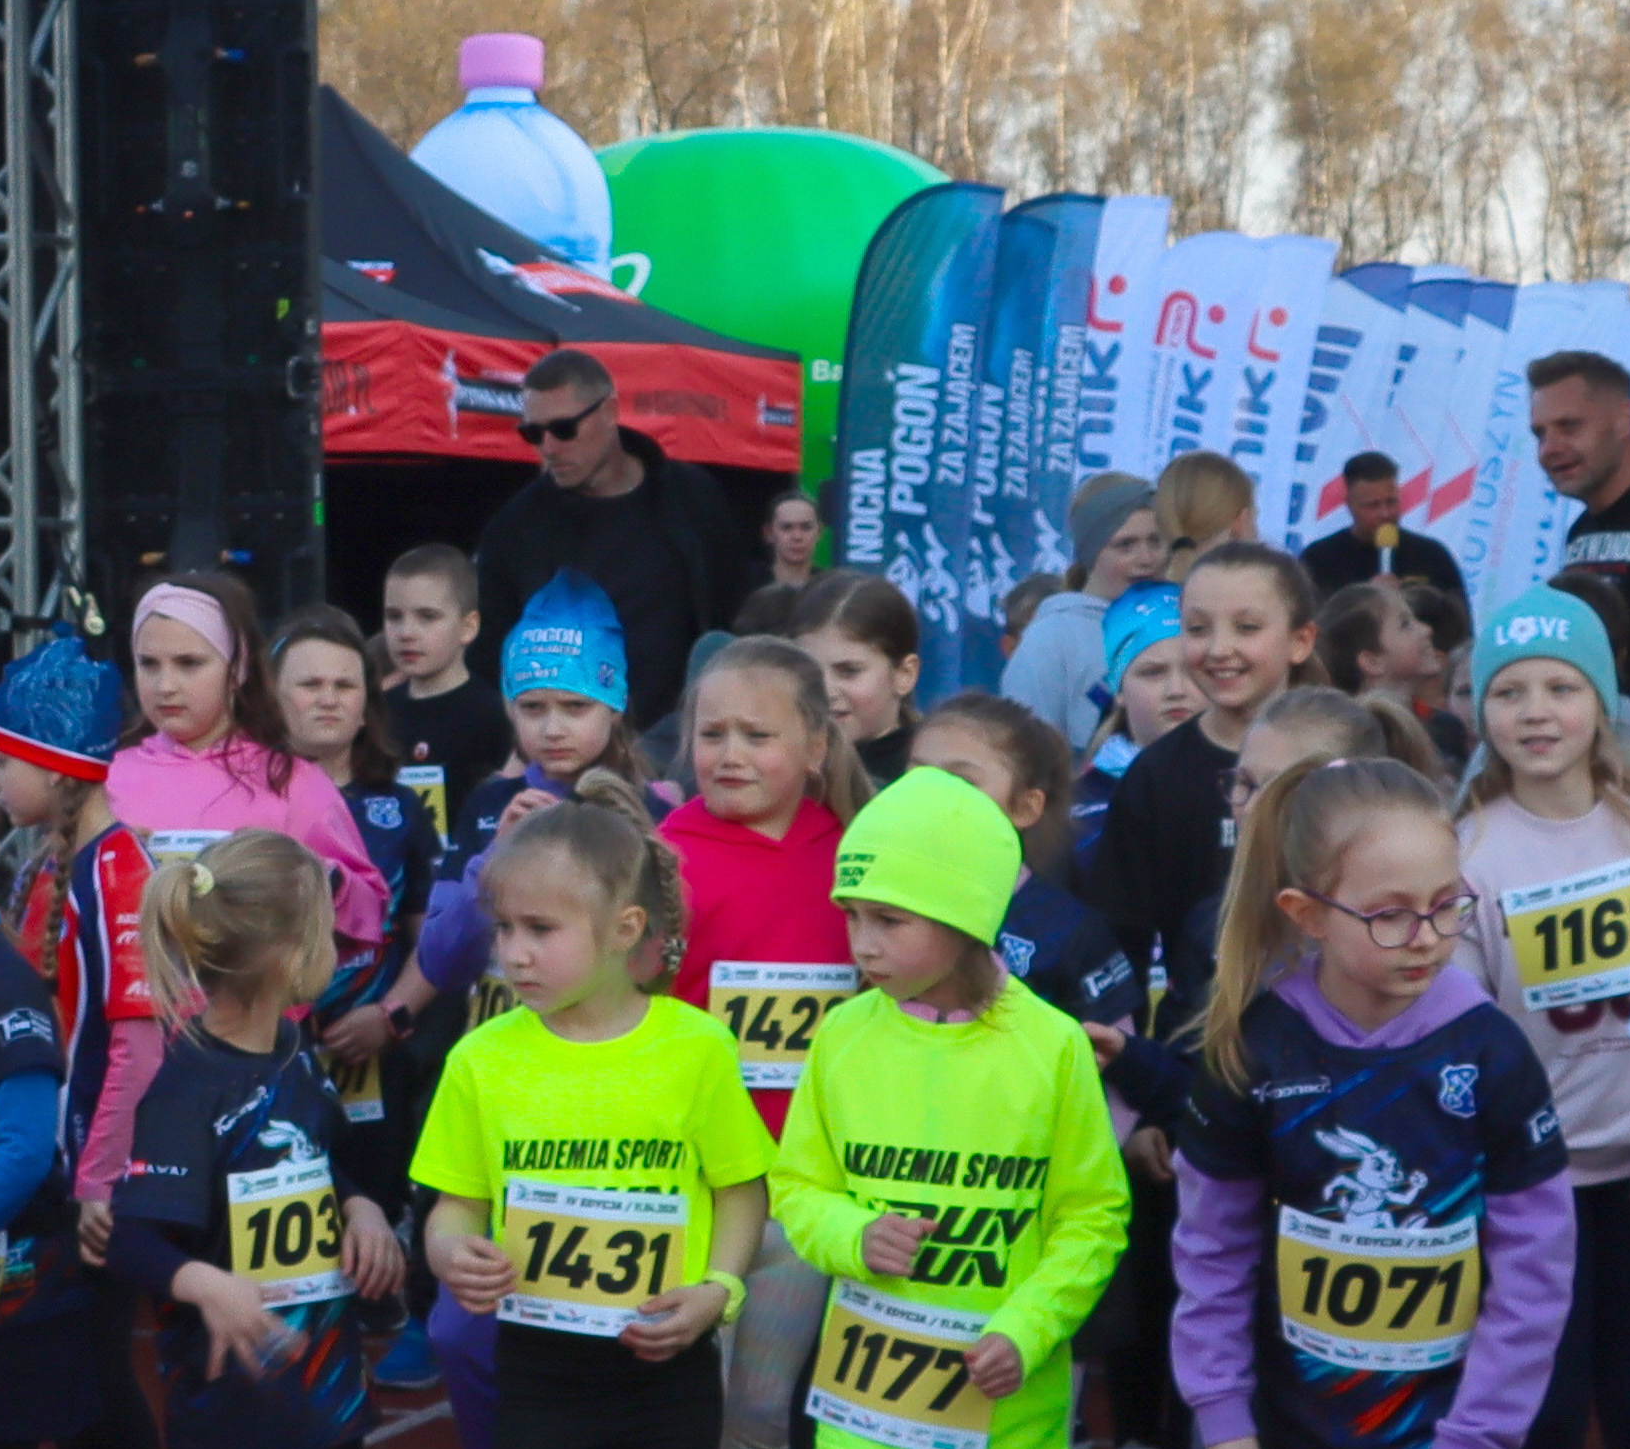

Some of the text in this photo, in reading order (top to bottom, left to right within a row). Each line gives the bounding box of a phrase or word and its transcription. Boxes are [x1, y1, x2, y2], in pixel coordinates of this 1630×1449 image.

[884, 363, 941, 516] POGOŃ
[846, 448, 886, 564] NOCNA
[614, 1137, 688, 1170] SPORT
[247, 1194, 342, 1271] 103
[525, 1221, 672, 1296] 1431
[1301, 1255, 1465, 1329] 1071
[834, 1323, 970, 1412] 1177
